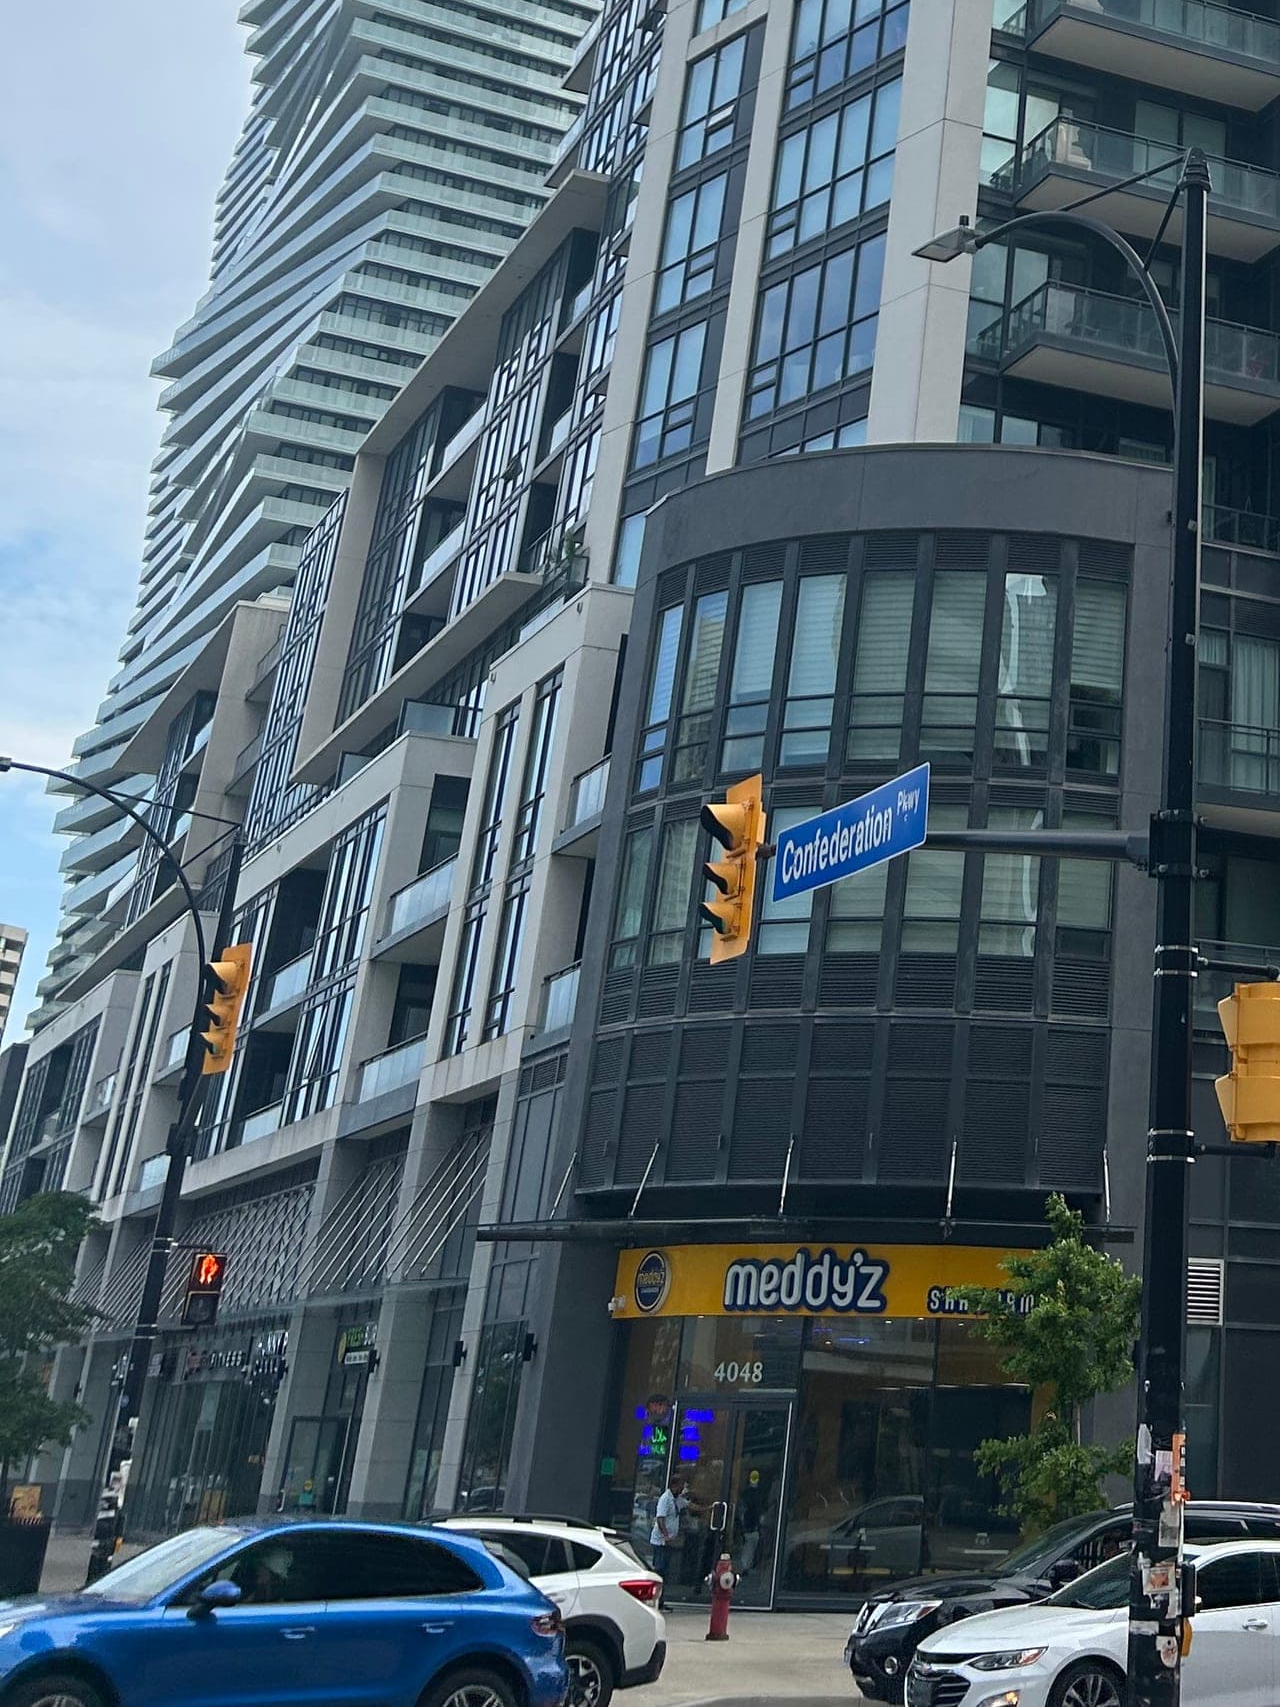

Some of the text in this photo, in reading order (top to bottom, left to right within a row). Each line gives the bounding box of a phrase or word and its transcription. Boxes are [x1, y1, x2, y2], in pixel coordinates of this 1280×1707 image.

[782, 787, 921, 884] Confederation Pkwy
[724, 1251, 884, 1308] meddy'z
[713, 1361, 764, 1383] 4048
